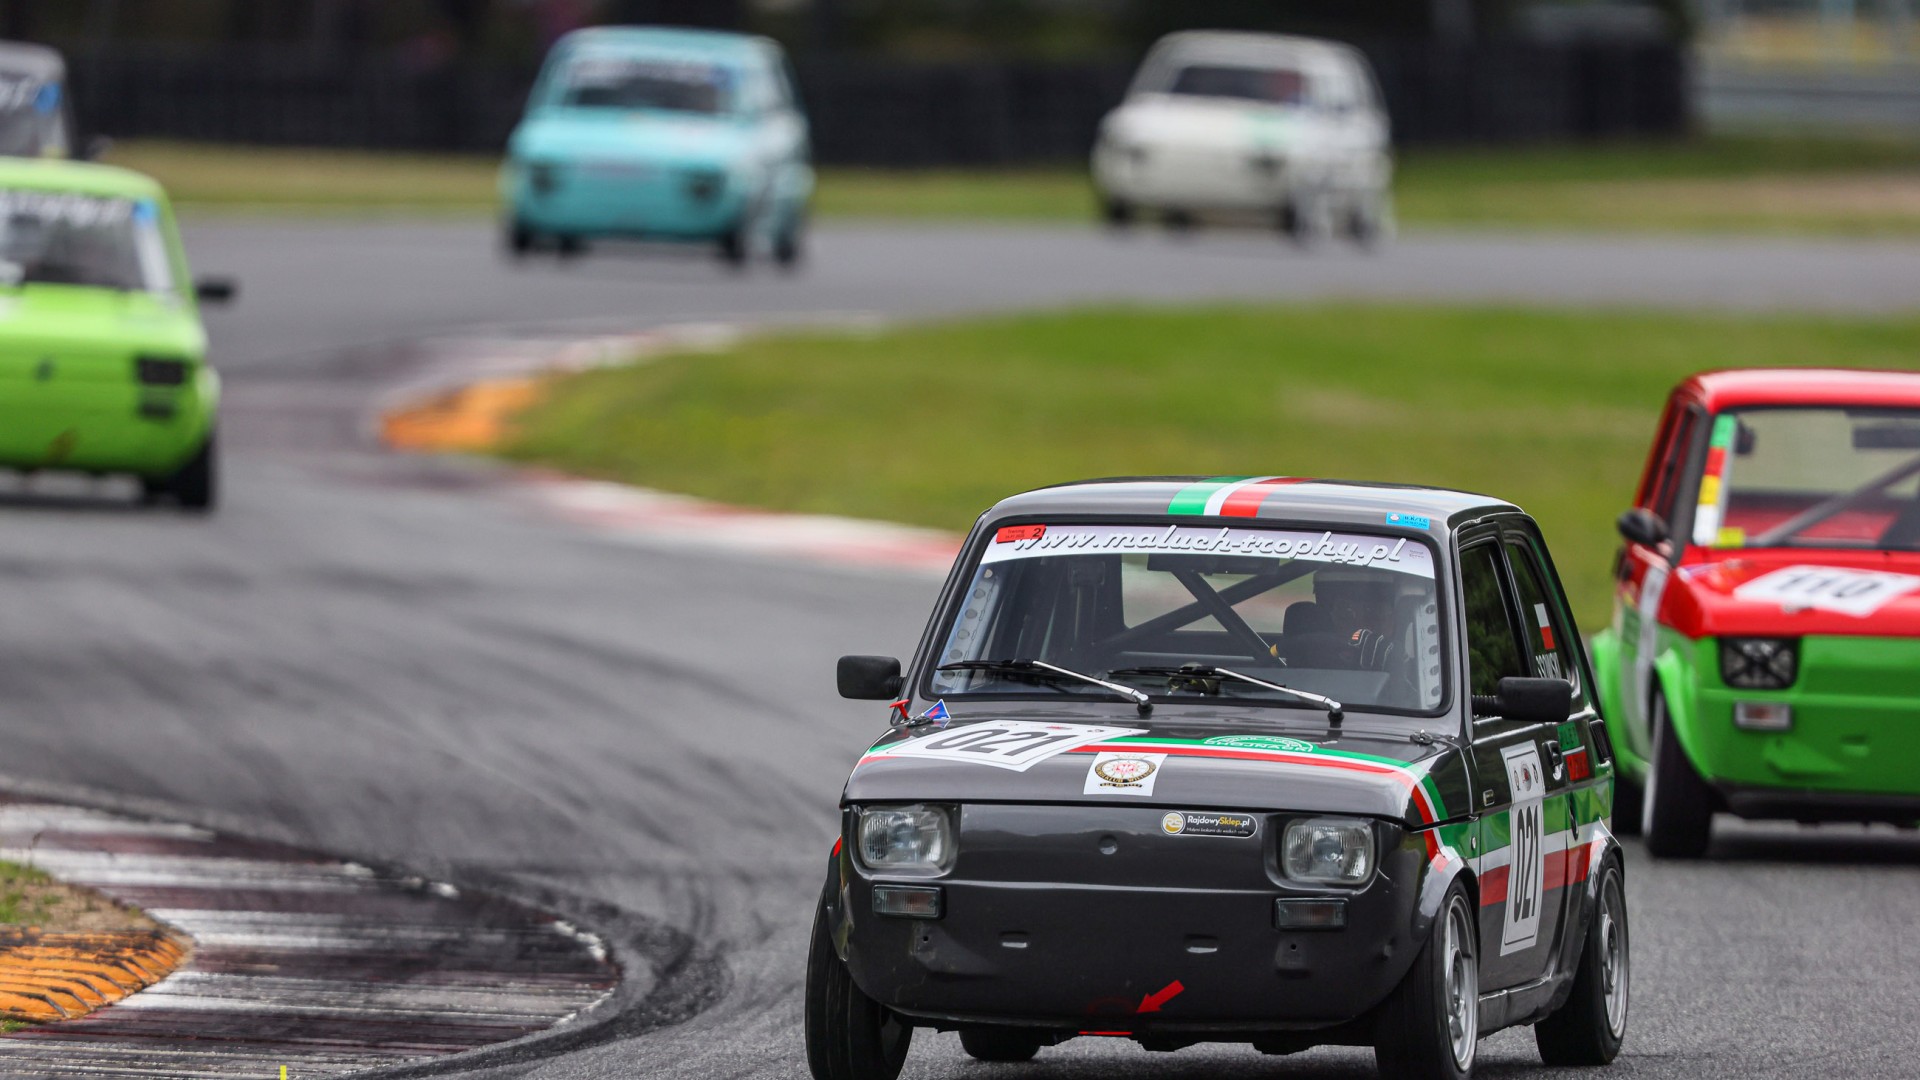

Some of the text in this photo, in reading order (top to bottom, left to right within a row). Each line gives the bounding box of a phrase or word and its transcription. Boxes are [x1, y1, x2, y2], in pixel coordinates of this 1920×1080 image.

[1015, 525, 1406, 566] www.maluch-trophy.pl
[1032, 528, 1042, 538] 2
[926, 729, 1080, 756] 021
[1187, 815, 1250, 828] RajdowySklep.pl
[1514, 805, 1539, 923] 021
